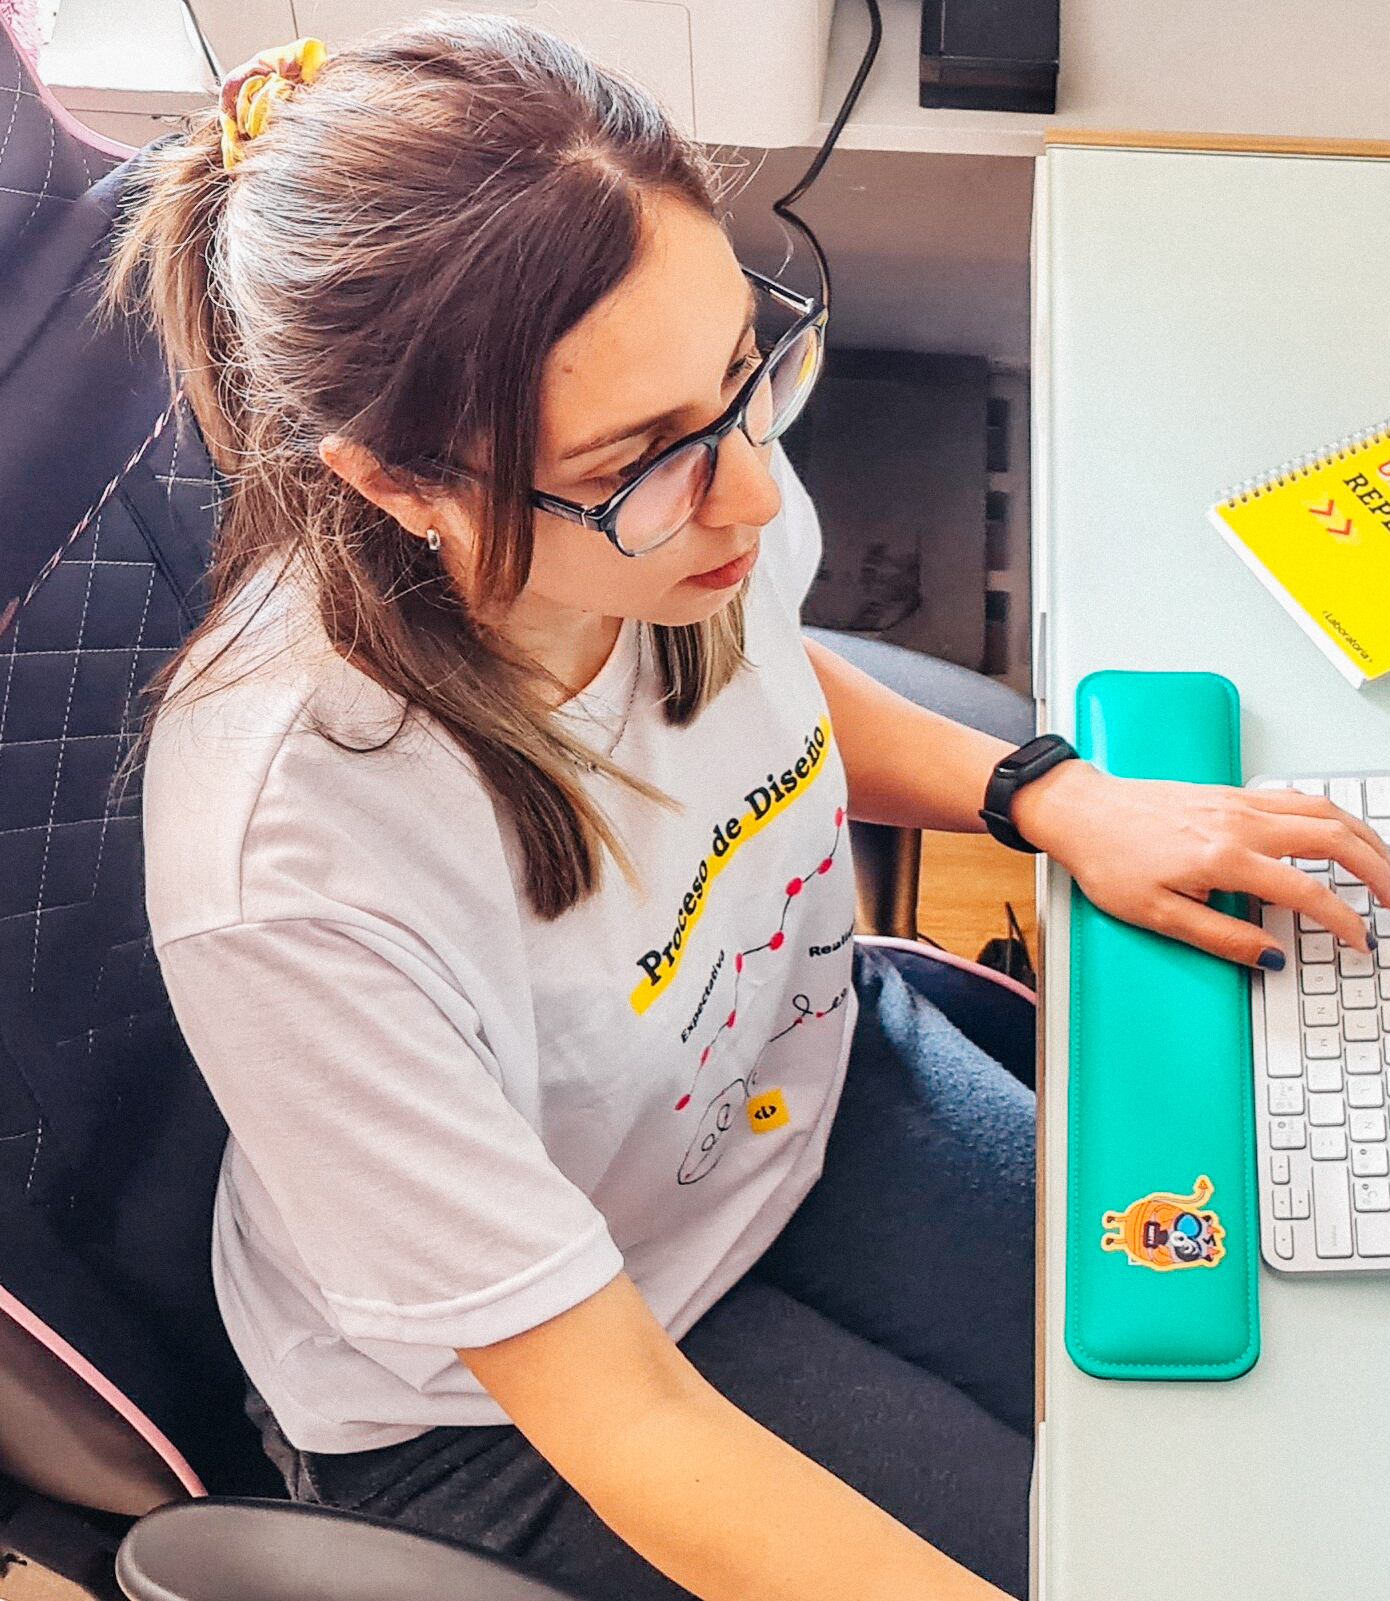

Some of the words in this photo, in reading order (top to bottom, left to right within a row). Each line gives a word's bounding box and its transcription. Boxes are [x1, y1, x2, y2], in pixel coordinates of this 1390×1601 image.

[637, 859, 708, 987] Proceso
[713, 818, 743, 857] de
[745, 725, 826, 820] Diseño
[680, 949, 725, 1043] Expectativa
